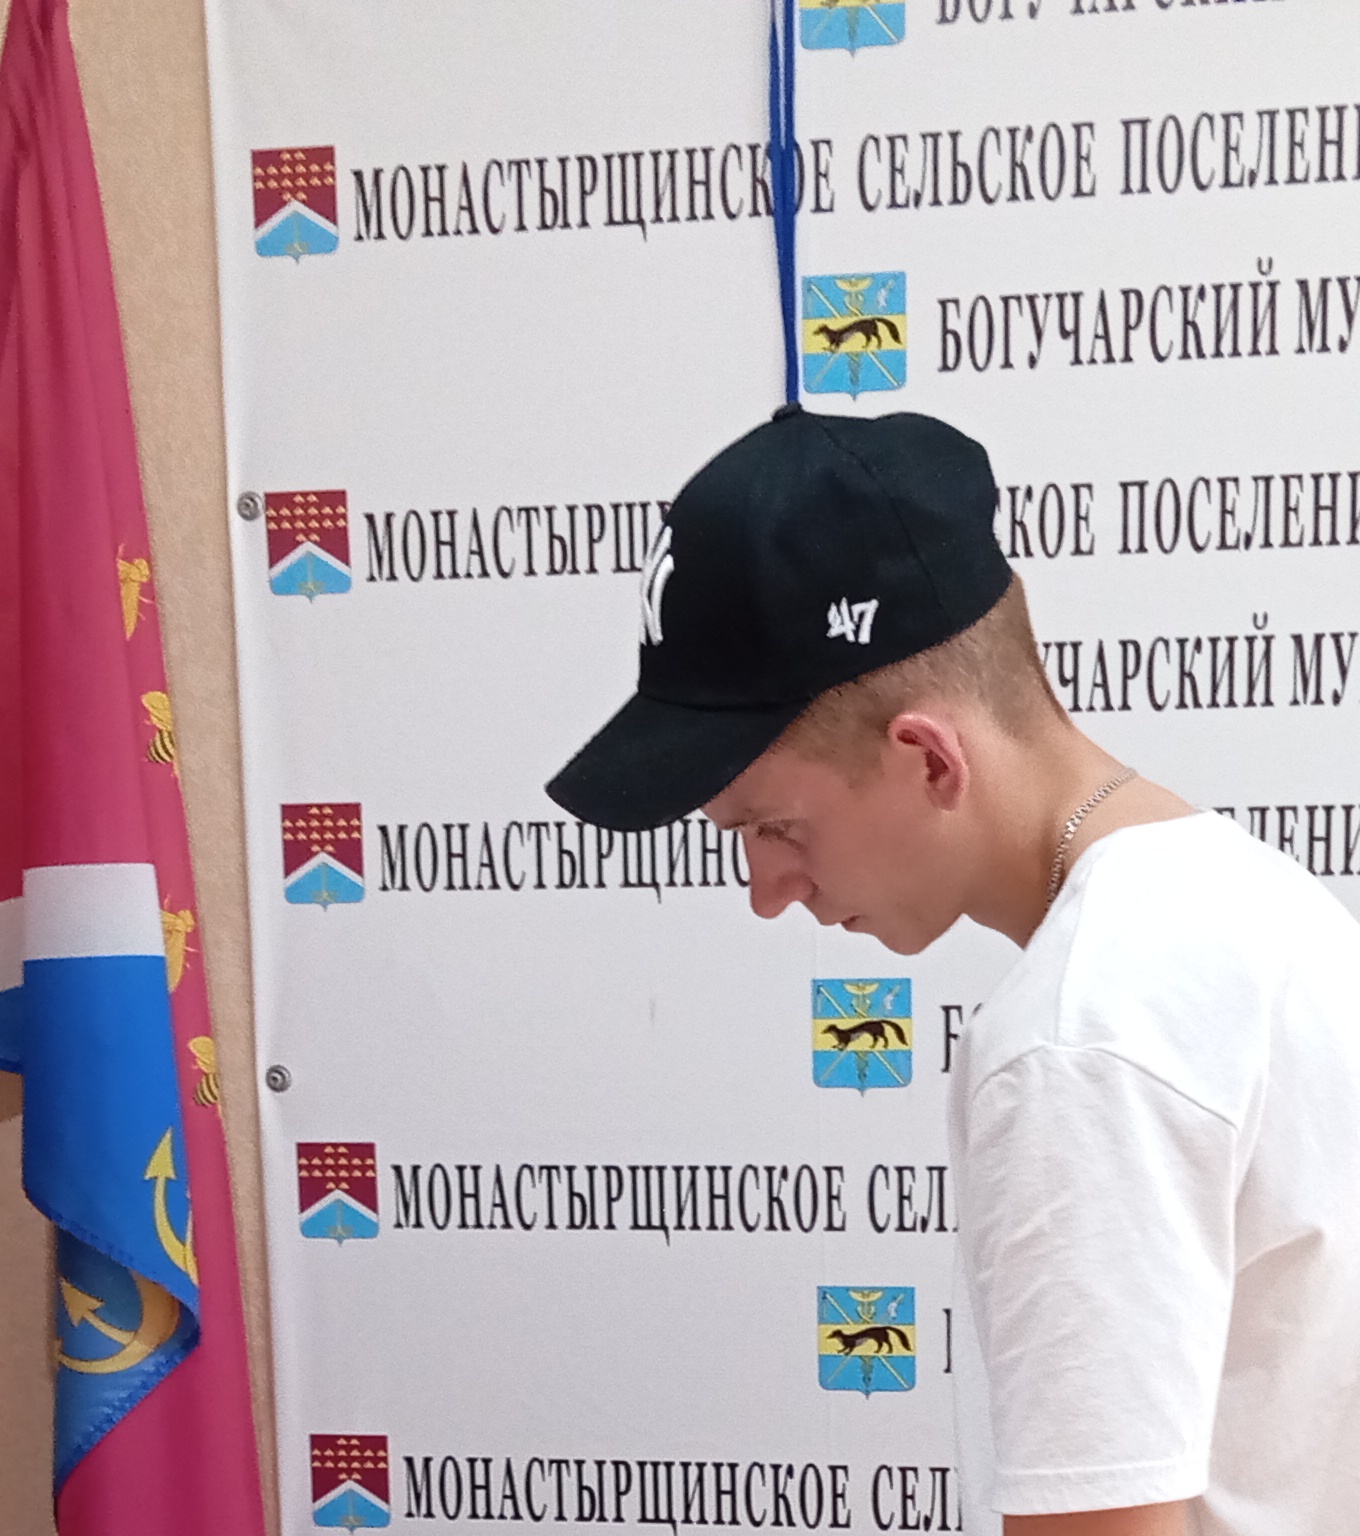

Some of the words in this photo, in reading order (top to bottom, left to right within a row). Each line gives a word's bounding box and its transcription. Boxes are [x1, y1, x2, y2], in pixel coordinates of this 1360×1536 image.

[857, 121, 1096, 213] СЕЛЬСКОЕ
[937, 257, 1281, 373] БОГУЧАРСКИЙ
[363, 501, 672, 582] МОНАСТЫРЩ
[1042, 612, 1275, 712] ЧАРСКИЙ
[377, 818, 749, 904] МОНАСТЫРЩИНС
[390, 1163, 846, 1246] МОНАСТЫРЩИНСКОЕ
